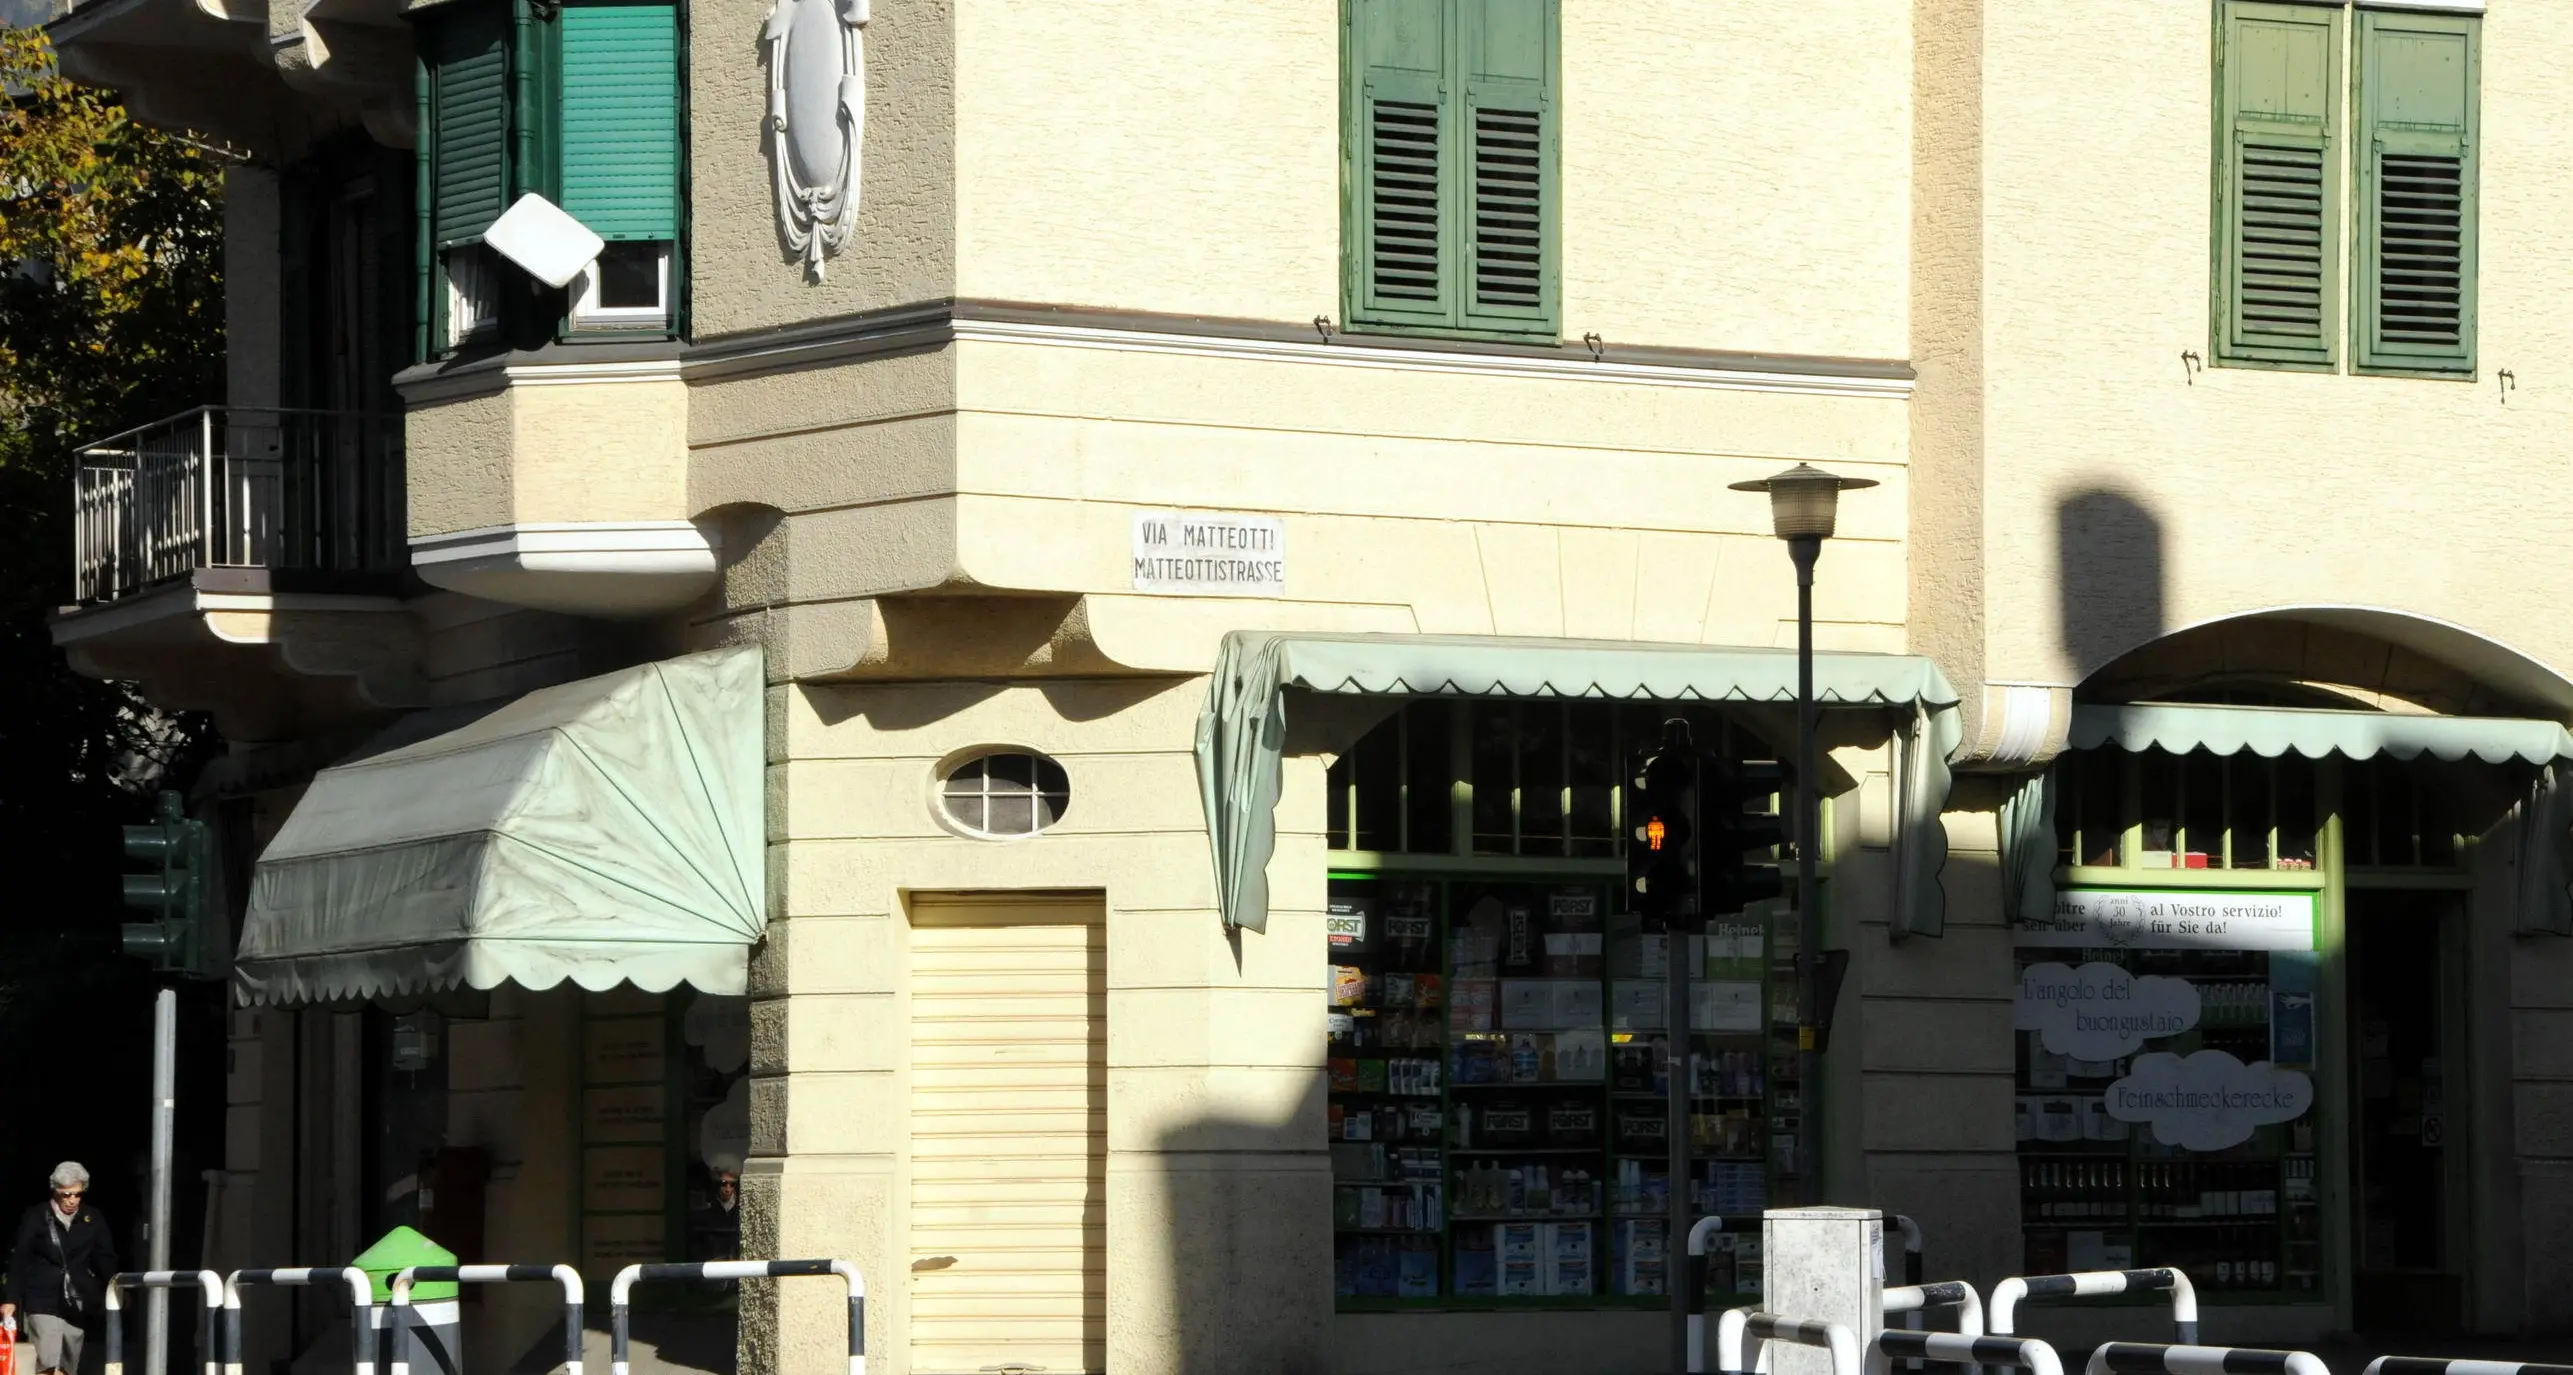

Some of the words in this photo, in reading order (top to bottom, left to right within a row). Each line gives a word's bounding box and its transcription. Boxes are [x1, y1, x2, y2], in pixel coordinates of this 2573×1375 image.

[1142, 521, 1168, 546] VIA
[1134, 557, 1283, 583] MATTEOTTISTRASSE
[2150, 903, 2164, 917] al
[2170, 903, 2216, 917] Vostro
[2222, 905, 2283, 918] servizio!
[1328, 919, 1361, 933] ORST
[2055, 919, 2086, 932] über
[2151, 920, 2172, 934] für
[2178, 920, 2200, 934] Sie
[2206, 921, 2227, 934] da!
[2110, 918, 2132, 928] Jahre
[2024, 978, 2095, 1008] L'angolo
[2102, 978, 2131, 1000] del
[2076, 1008, 2184, 1040] buongustaio
[2117, 1085, 2294, 1109] Feinschmeckerecke
